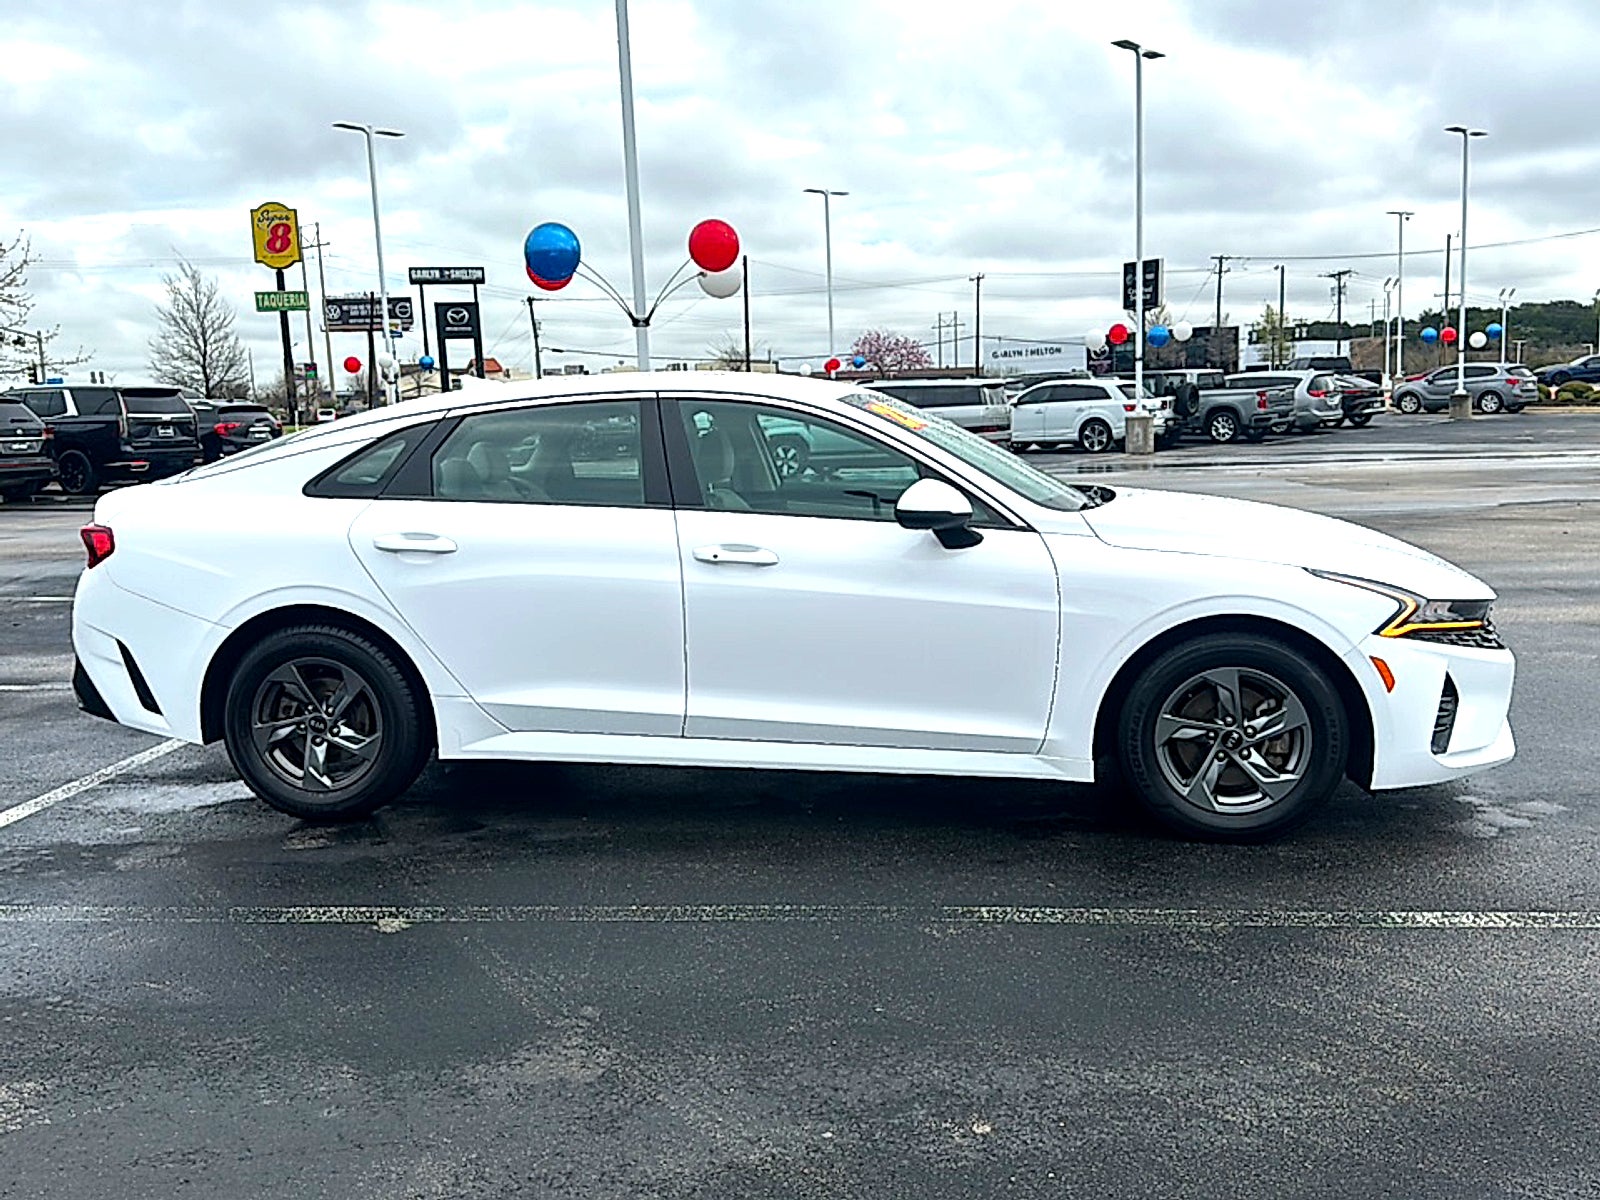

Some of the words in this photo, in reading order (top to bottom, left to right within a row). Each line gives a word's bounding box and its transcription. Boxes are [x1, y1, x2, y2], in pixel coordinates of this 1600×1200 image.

[257, 209, 290, 228] Super
[265, 223, 291, 255] 8
[257, 293, 307, 308] TAQUERIA
